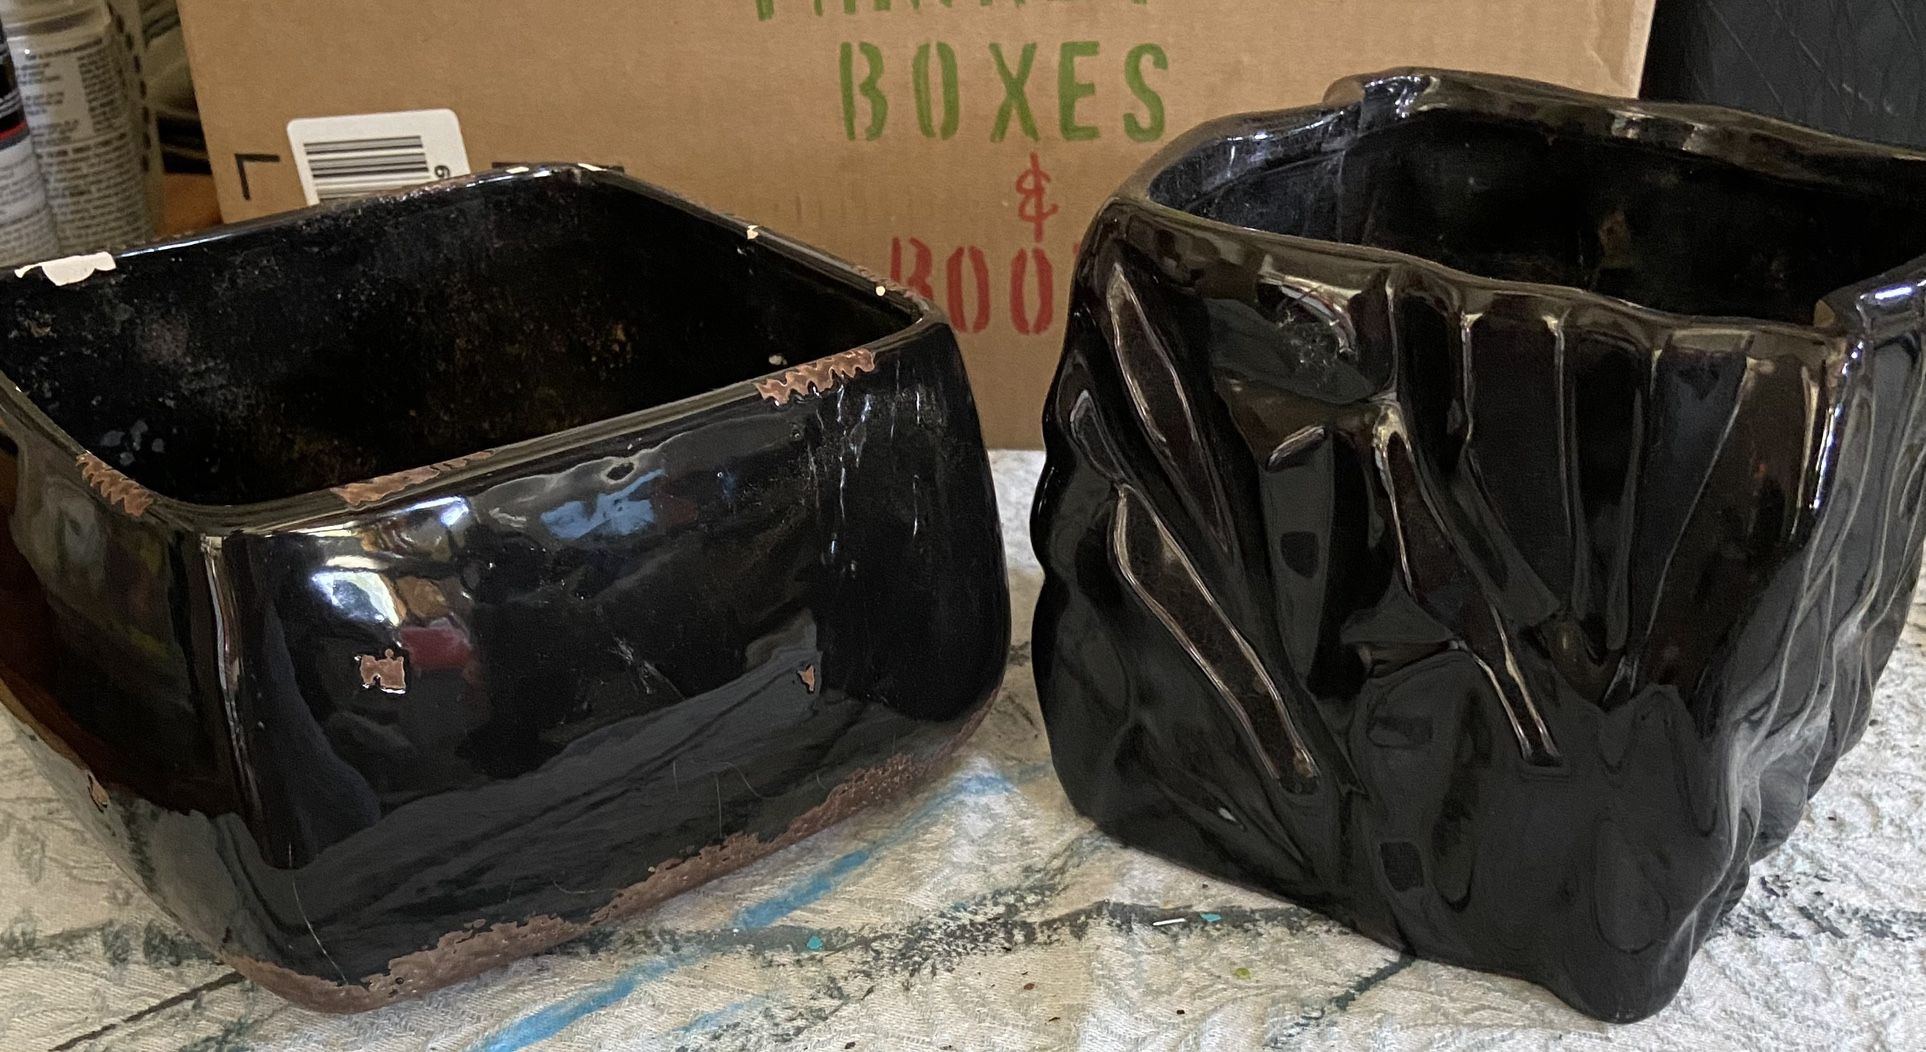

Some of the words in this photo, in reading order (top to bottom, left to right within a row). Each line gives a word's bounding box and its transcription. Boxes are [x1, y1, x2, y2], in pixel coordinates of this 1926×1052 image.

[839, 41, 1168, 142] BOXES
[1015, 152, 1059, 242] &
[890, 237, 1082, 335] BOO
